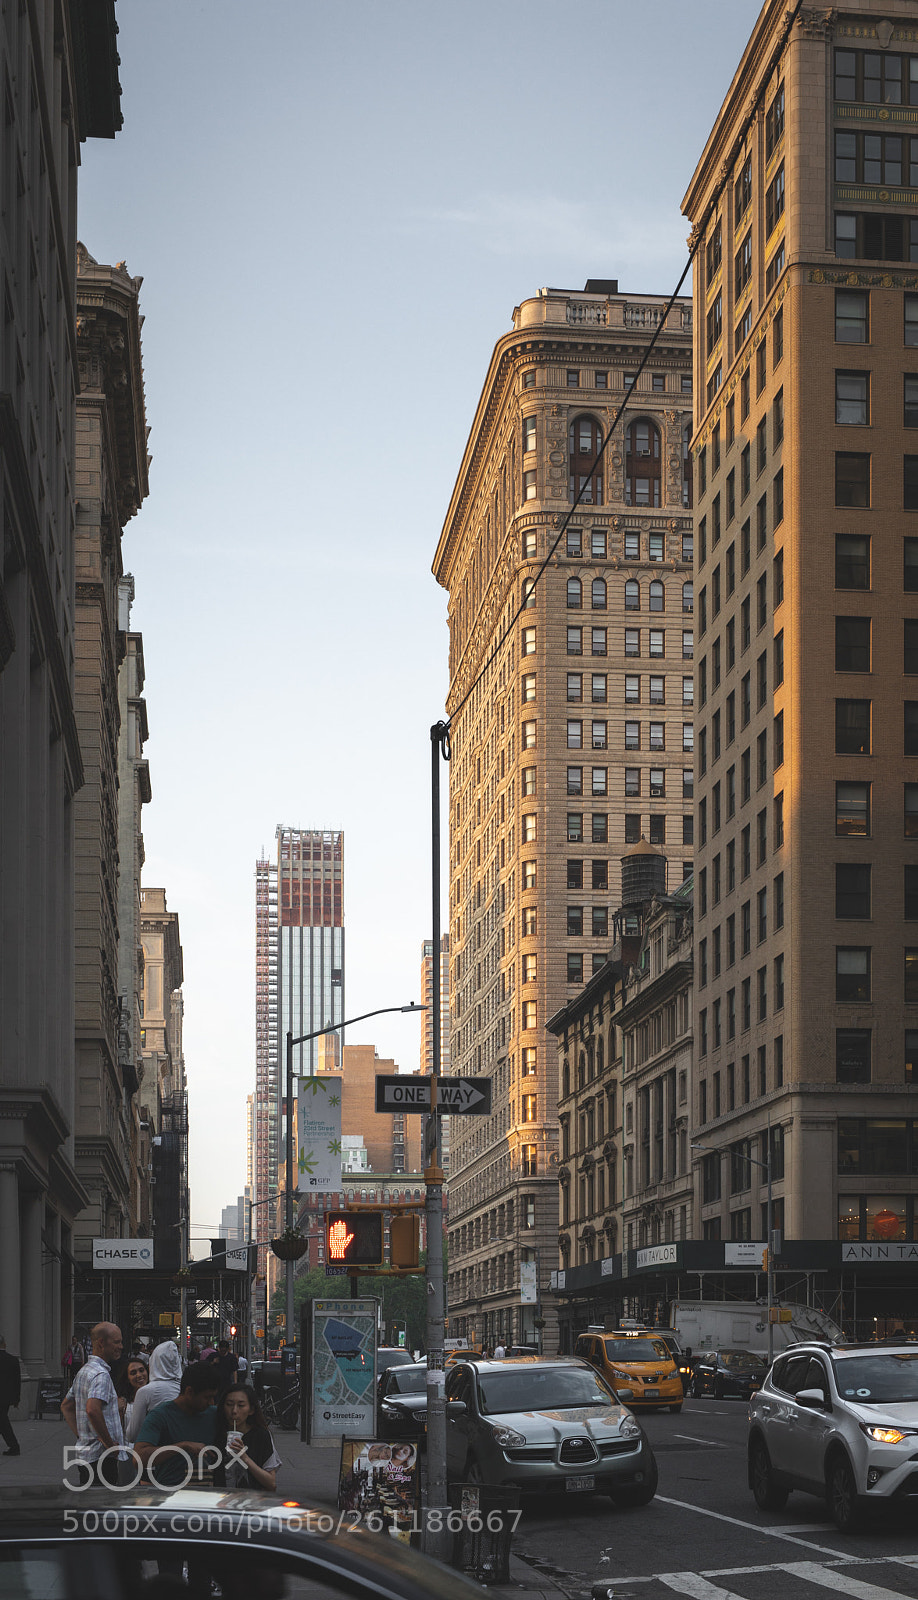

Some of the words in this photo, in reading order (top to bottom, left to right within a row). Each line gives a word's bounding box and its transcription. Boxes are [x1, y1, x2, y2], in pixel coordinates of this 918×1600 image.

[393, 1088, 425, 1102] ONE
[440, 1089, 473, 1104] WAY
[95, 1249, 137, 1258] CHASE
[225, 1250, 242, 1260] CHASE
[637, 1253, 648, 1265] ANN
[648, 1247, 675, 1262] TAYLOR
[846, 1246, 889, 1258] ANN
[896, 1246, 918, 1258] TA
[326, 1302, 364, 1310] Phone
[332, 1412, 365, 1420] StreetEasy
